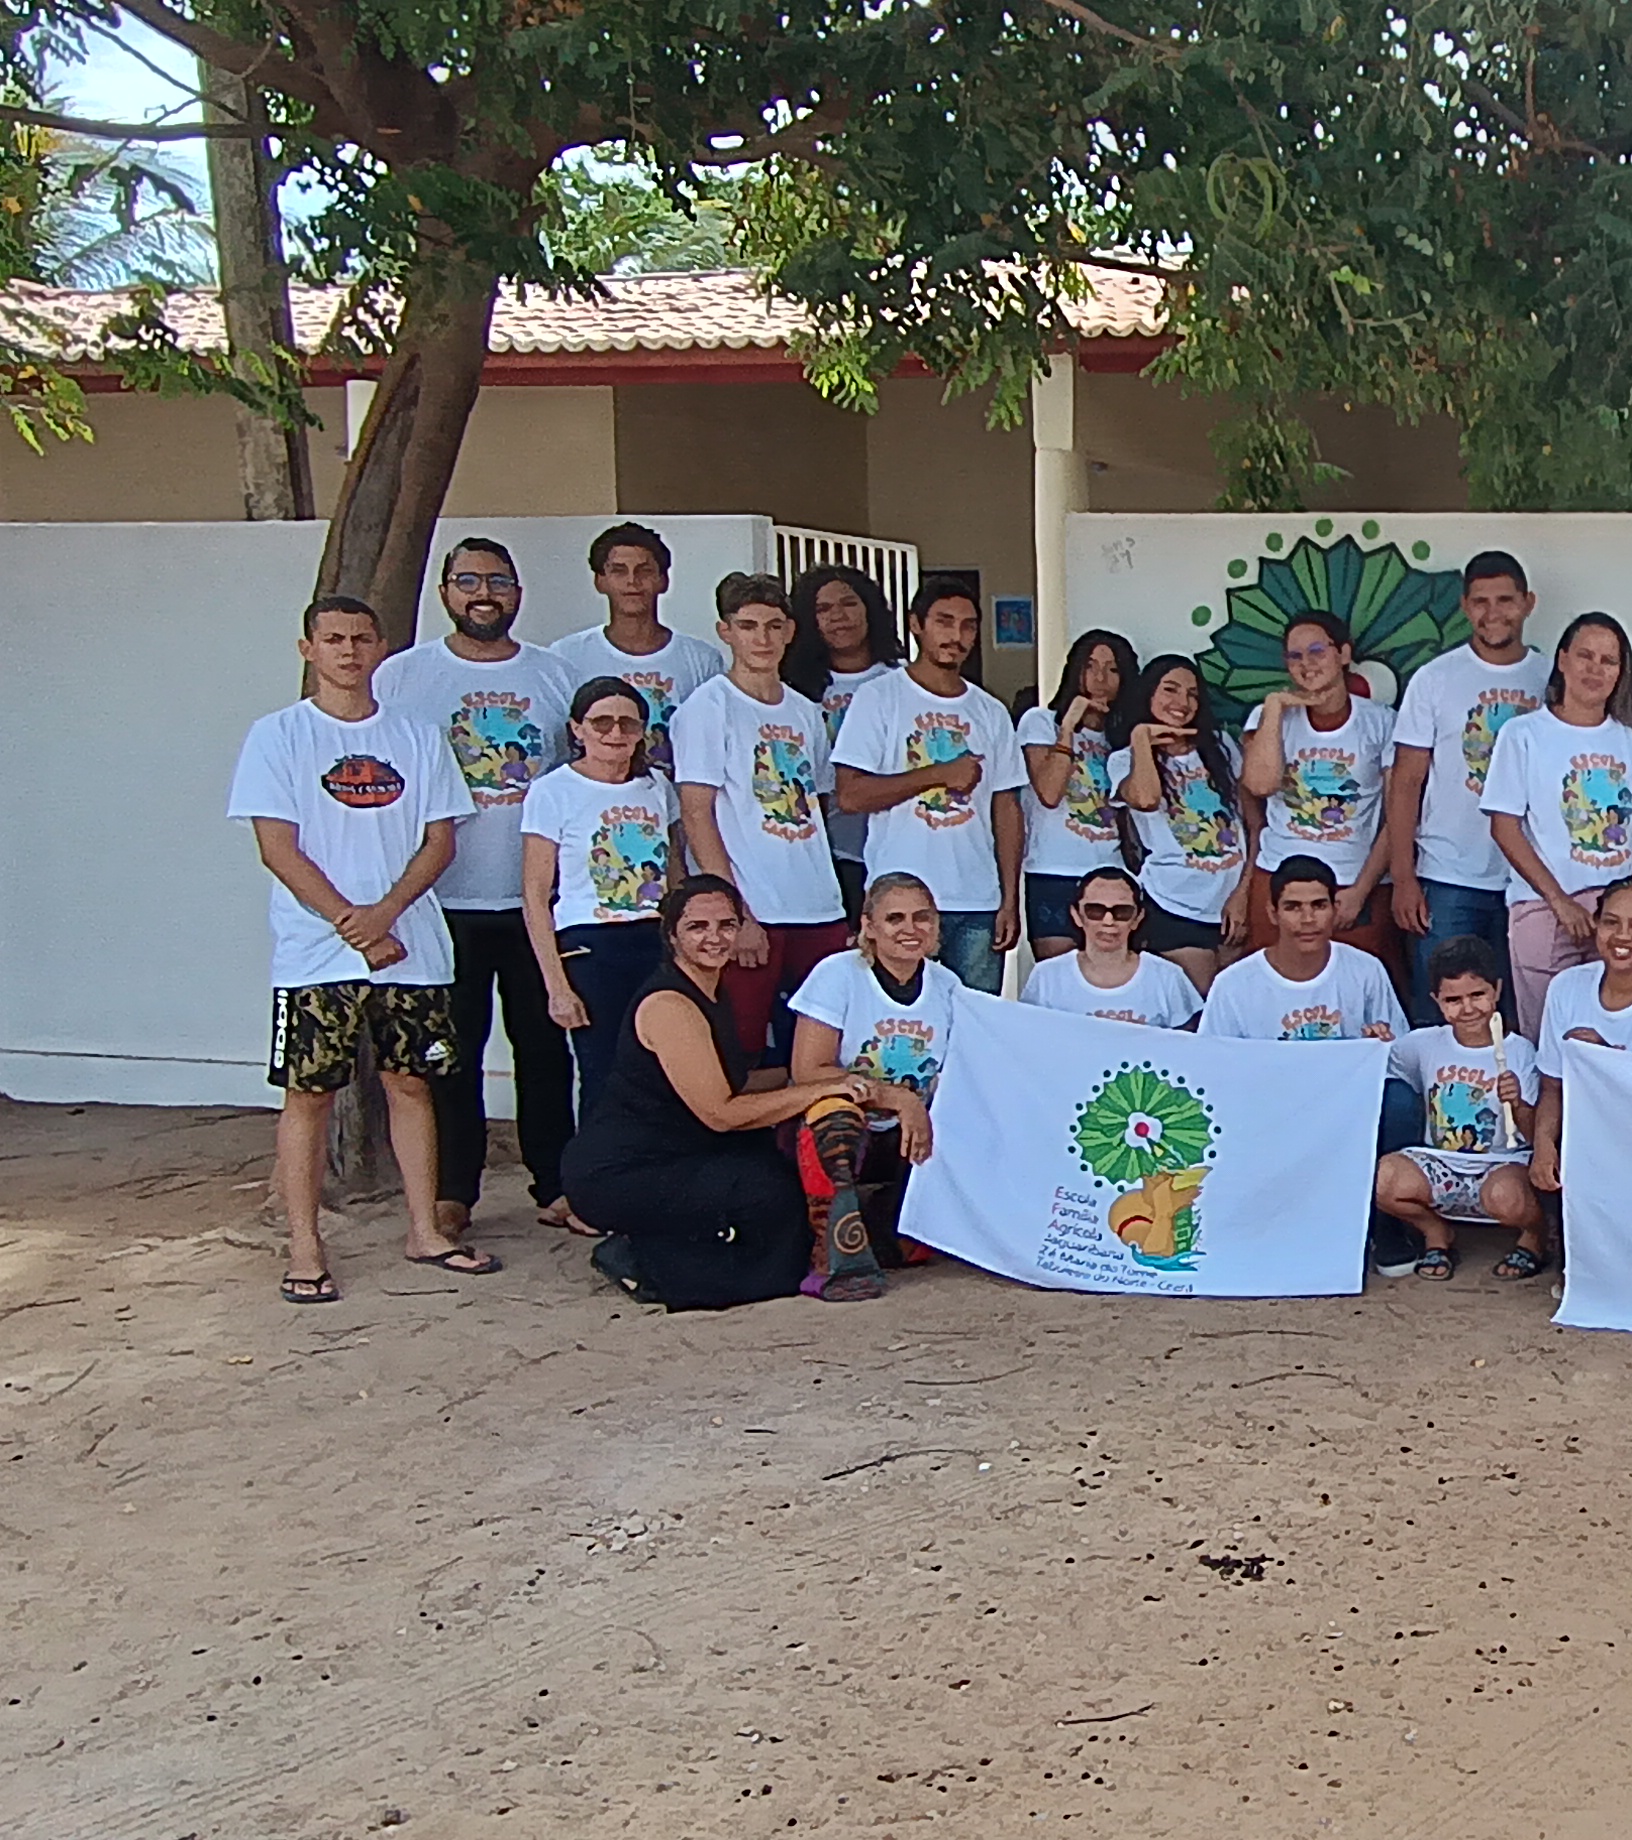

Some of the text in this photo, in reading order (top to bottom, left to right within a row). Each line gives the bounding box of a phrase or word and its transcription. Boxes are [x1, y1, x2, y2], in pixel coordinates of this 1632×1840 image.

[1477, 687, 1538, 709] ESCOLA
[1569, 753, 1627, 775] ESCOLA
[600, 805, 660, 828] ESCOLA
[1280, 1004, 1342, 1031] ESCOLA
[1436, 1064, 1497, 1093] ESCOLA
[1055, 1186, 1098, 1208] Escola
